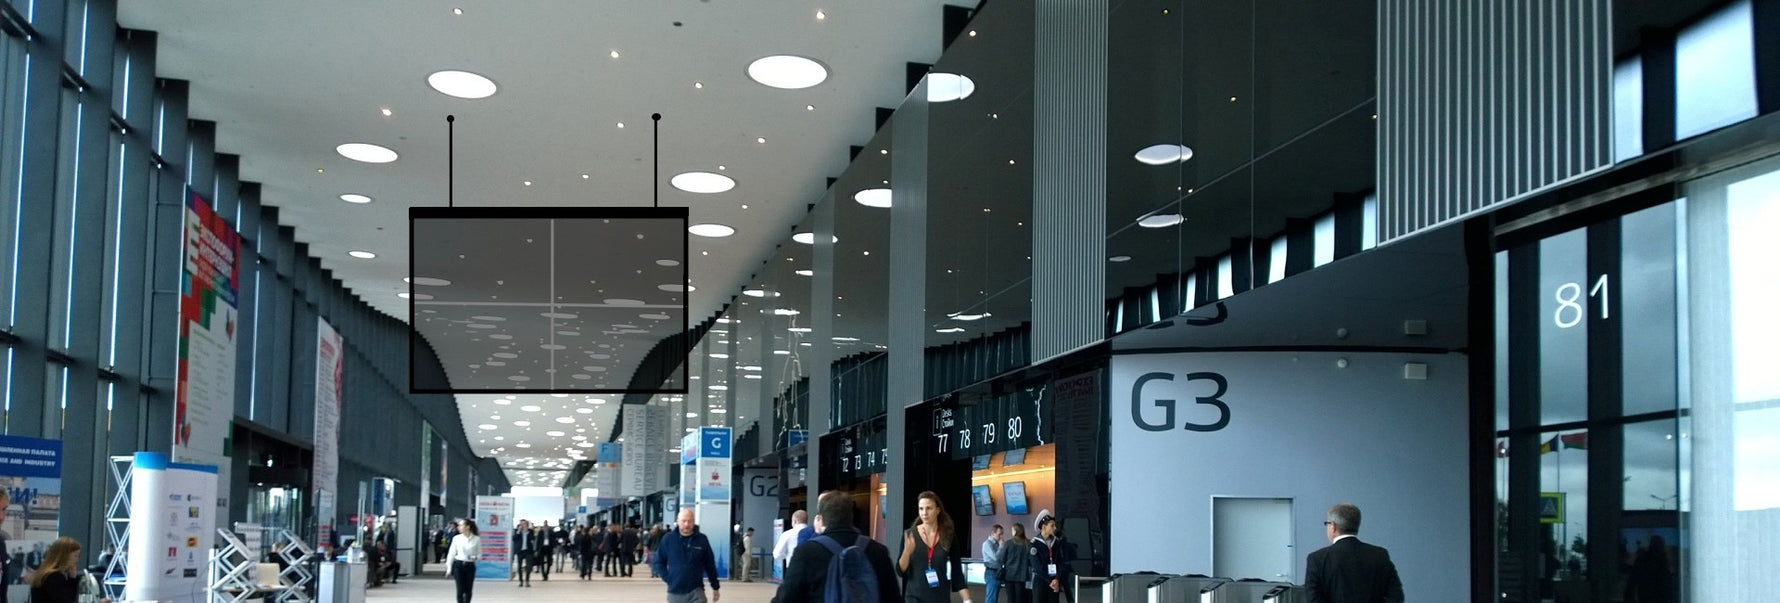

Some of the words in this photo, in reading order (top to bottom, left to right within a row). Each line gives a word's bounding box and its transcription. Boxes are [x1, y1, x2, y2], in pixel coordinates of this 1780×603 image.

[1555, 274, 1609, 328] 81
[1131, 371, 1231, 432] G3
[635, 408, 644, 448] SERVICE
[938, 433, 949, 453] 77
[960, 428, 971, 449] 78
[983, 422, 995, 444] 79
[1008, 416, 1022, 440] 80
[31, 449, 56, 457] ПАЛАТА
[711, 437, 722, 449] G
[24, 459, 56, 468] INDUSTRY
[633, 453, 644, 491] BUREAU
[855, 454, 861, 470] 73
[867, 451, 875, 467] 74
[750, 475, 778, 497] G2
